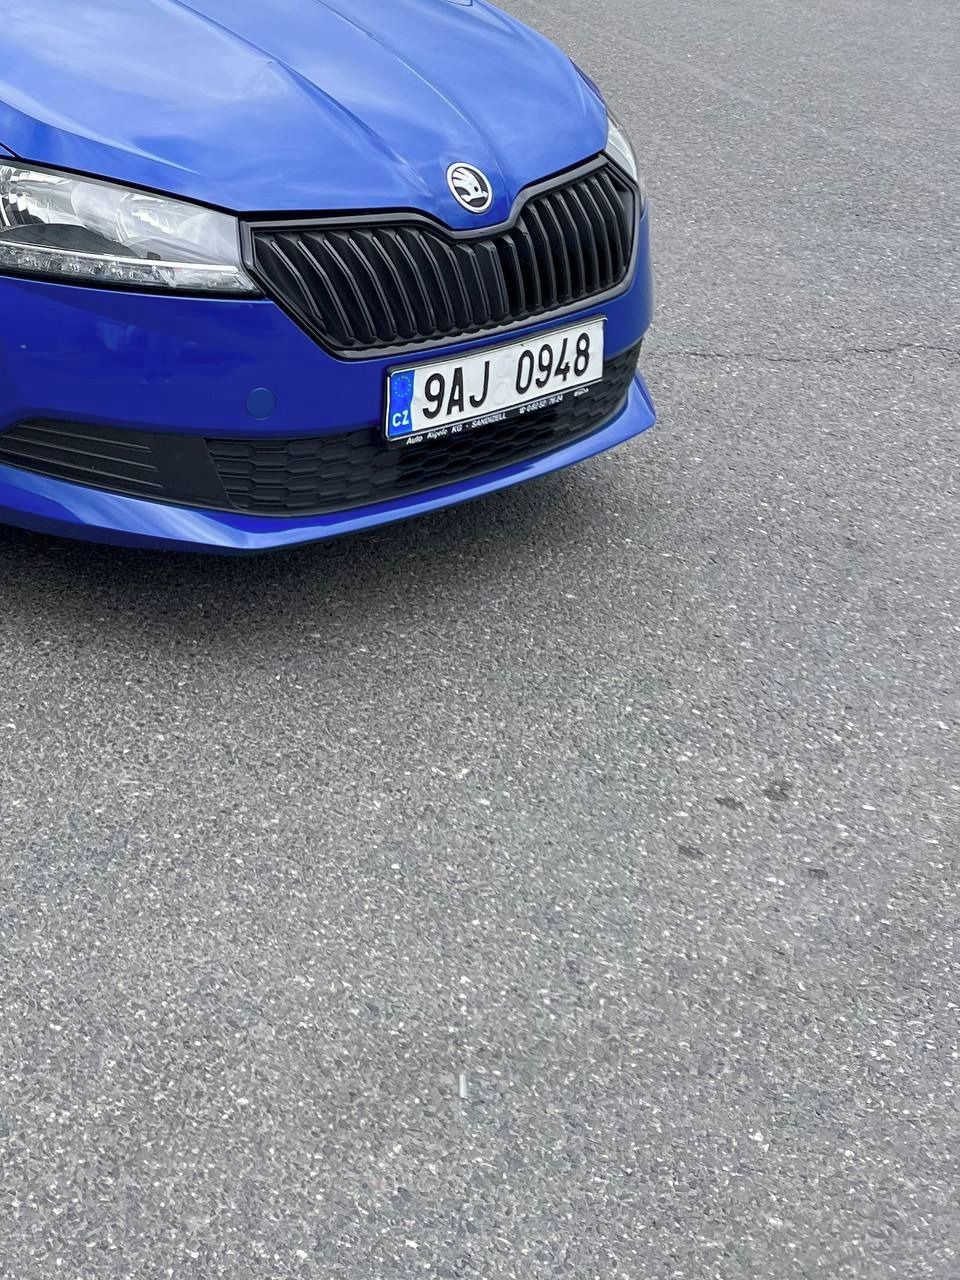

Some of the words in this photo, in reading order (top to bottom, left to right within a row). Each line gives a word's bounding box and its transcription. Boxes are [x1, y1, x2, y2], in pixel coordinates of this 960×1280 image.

[422, 360, 491, 419] 9AJ
[515, 332, 591, 395] 0948
[391, 409, 410, 428] CZ
[406, 434, 423, 445] Auto
